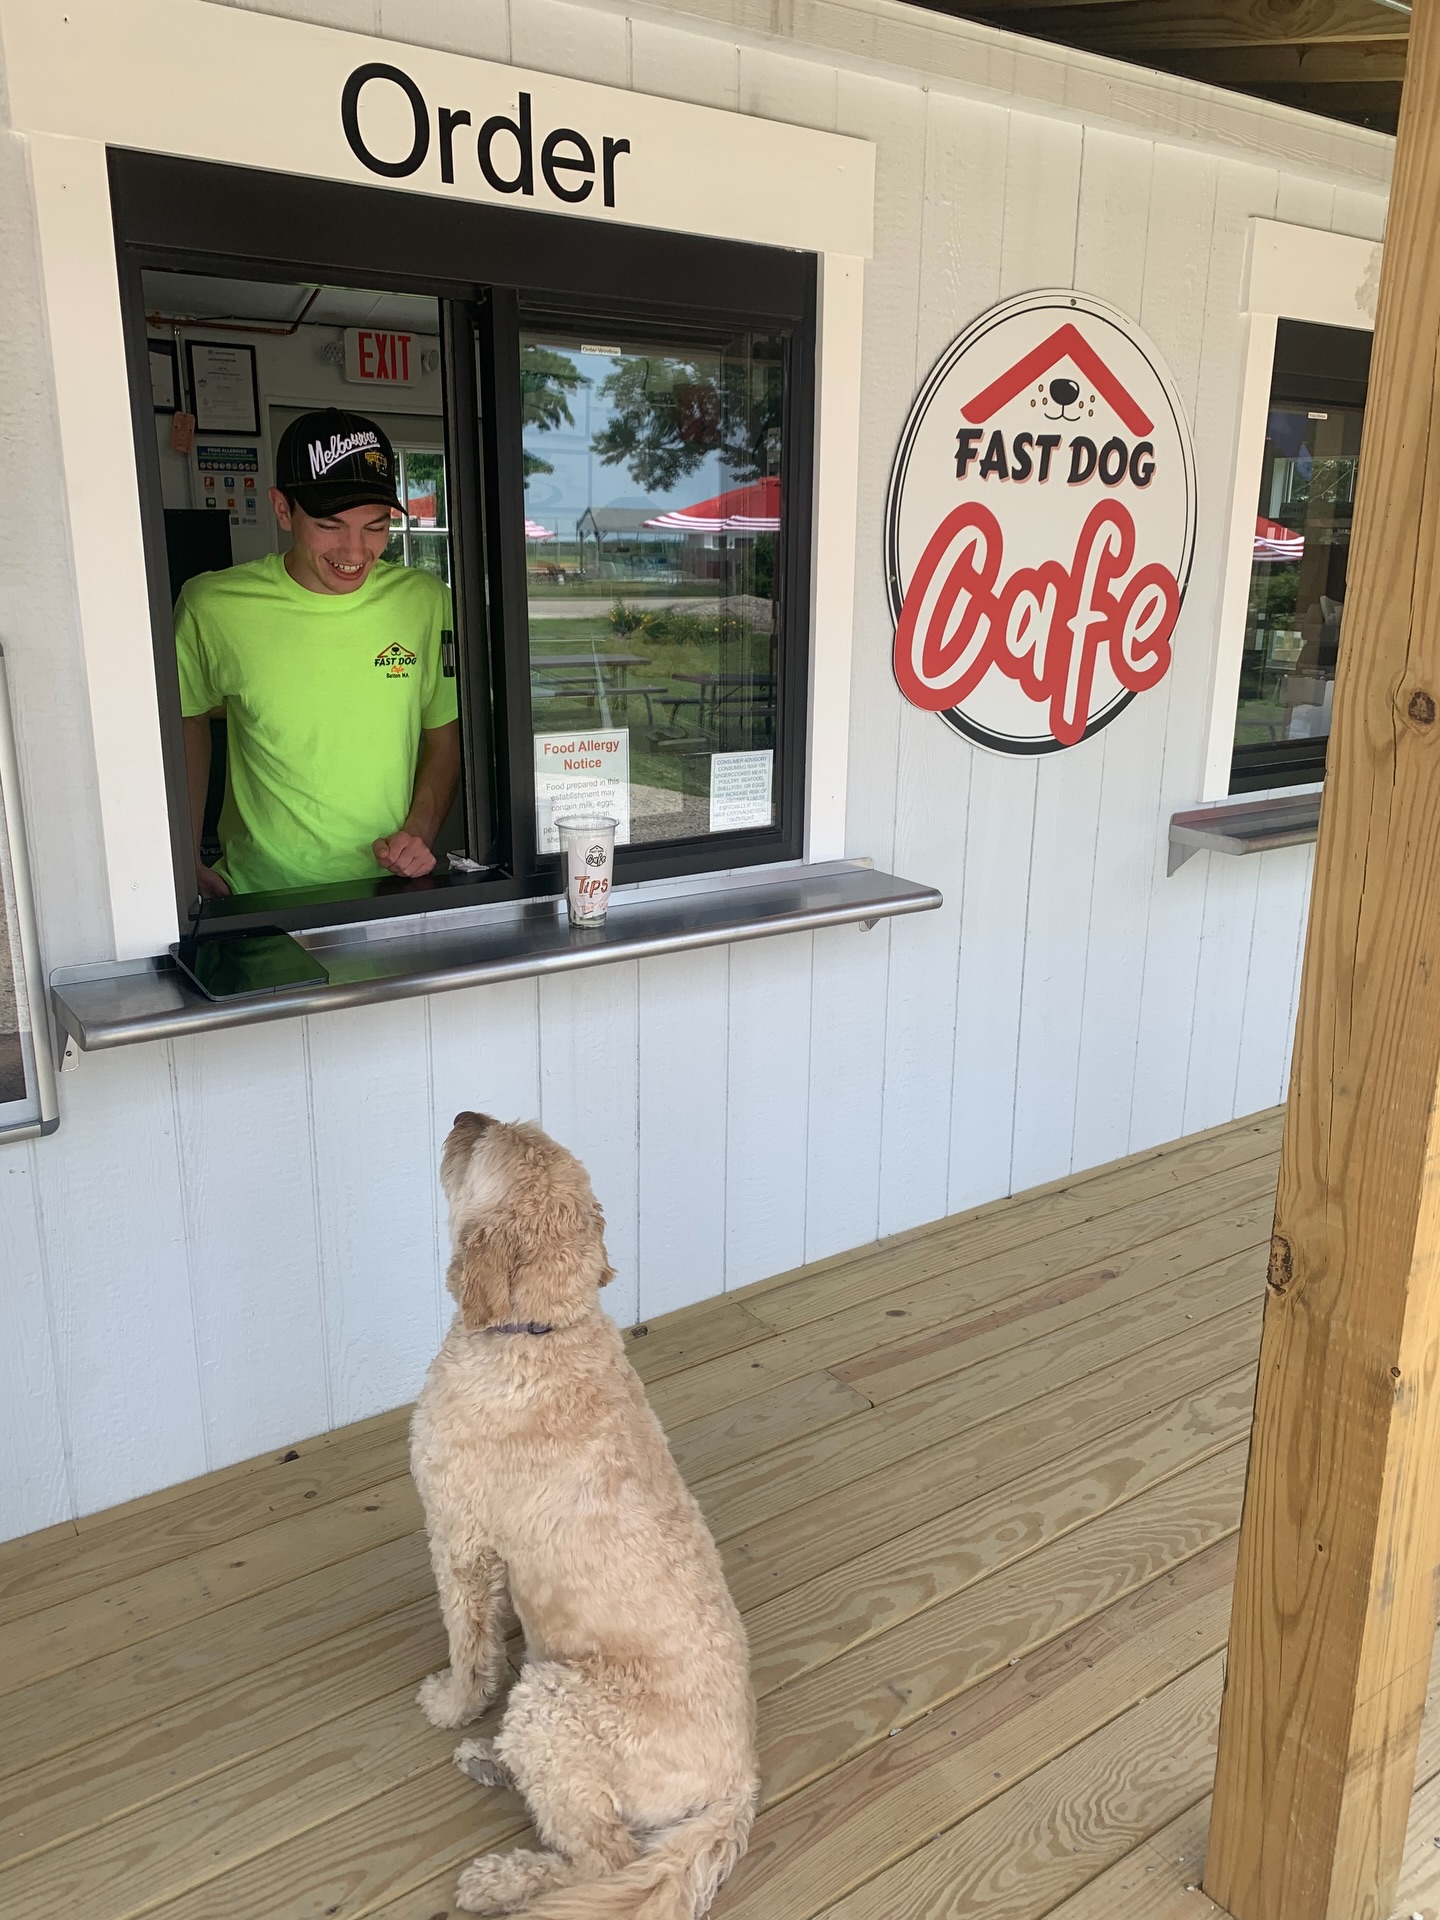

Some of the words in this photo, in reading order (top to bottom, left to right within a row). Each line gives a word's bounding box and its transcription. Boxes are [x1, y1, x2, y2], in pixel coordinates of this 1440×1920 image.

[341, 62, 630, 208] Order
[358, 331, 411, 380] EXIT
[308, 431, 380, 479] Melbourne
[954, 428, 1062, 485] FAST
[1066, 436, 1156, 487] DOG
[894, 498, 1180, 746] Cafe
[374, 657, 397, 667] FAST
[398, 657, 417, 666] DOG
[544, 741, 575, 755] Food
[578, 740, 620, 752] Allergy
[564, 758, 602, 770] Notice
[718, 764, 747, 772] CONSUMING
[714, 770, 751, 779] UNDERCOOKED
[546, 782, 565, 791] Food
[566, 780, 598, 791] prepared
[600, 779, 606, 787] in
[607, 777, 620, 785] this
[550, 791, 600, 802] establishment
[601, 790, 616, 798] may
[551, 803, 577, 812] contain
